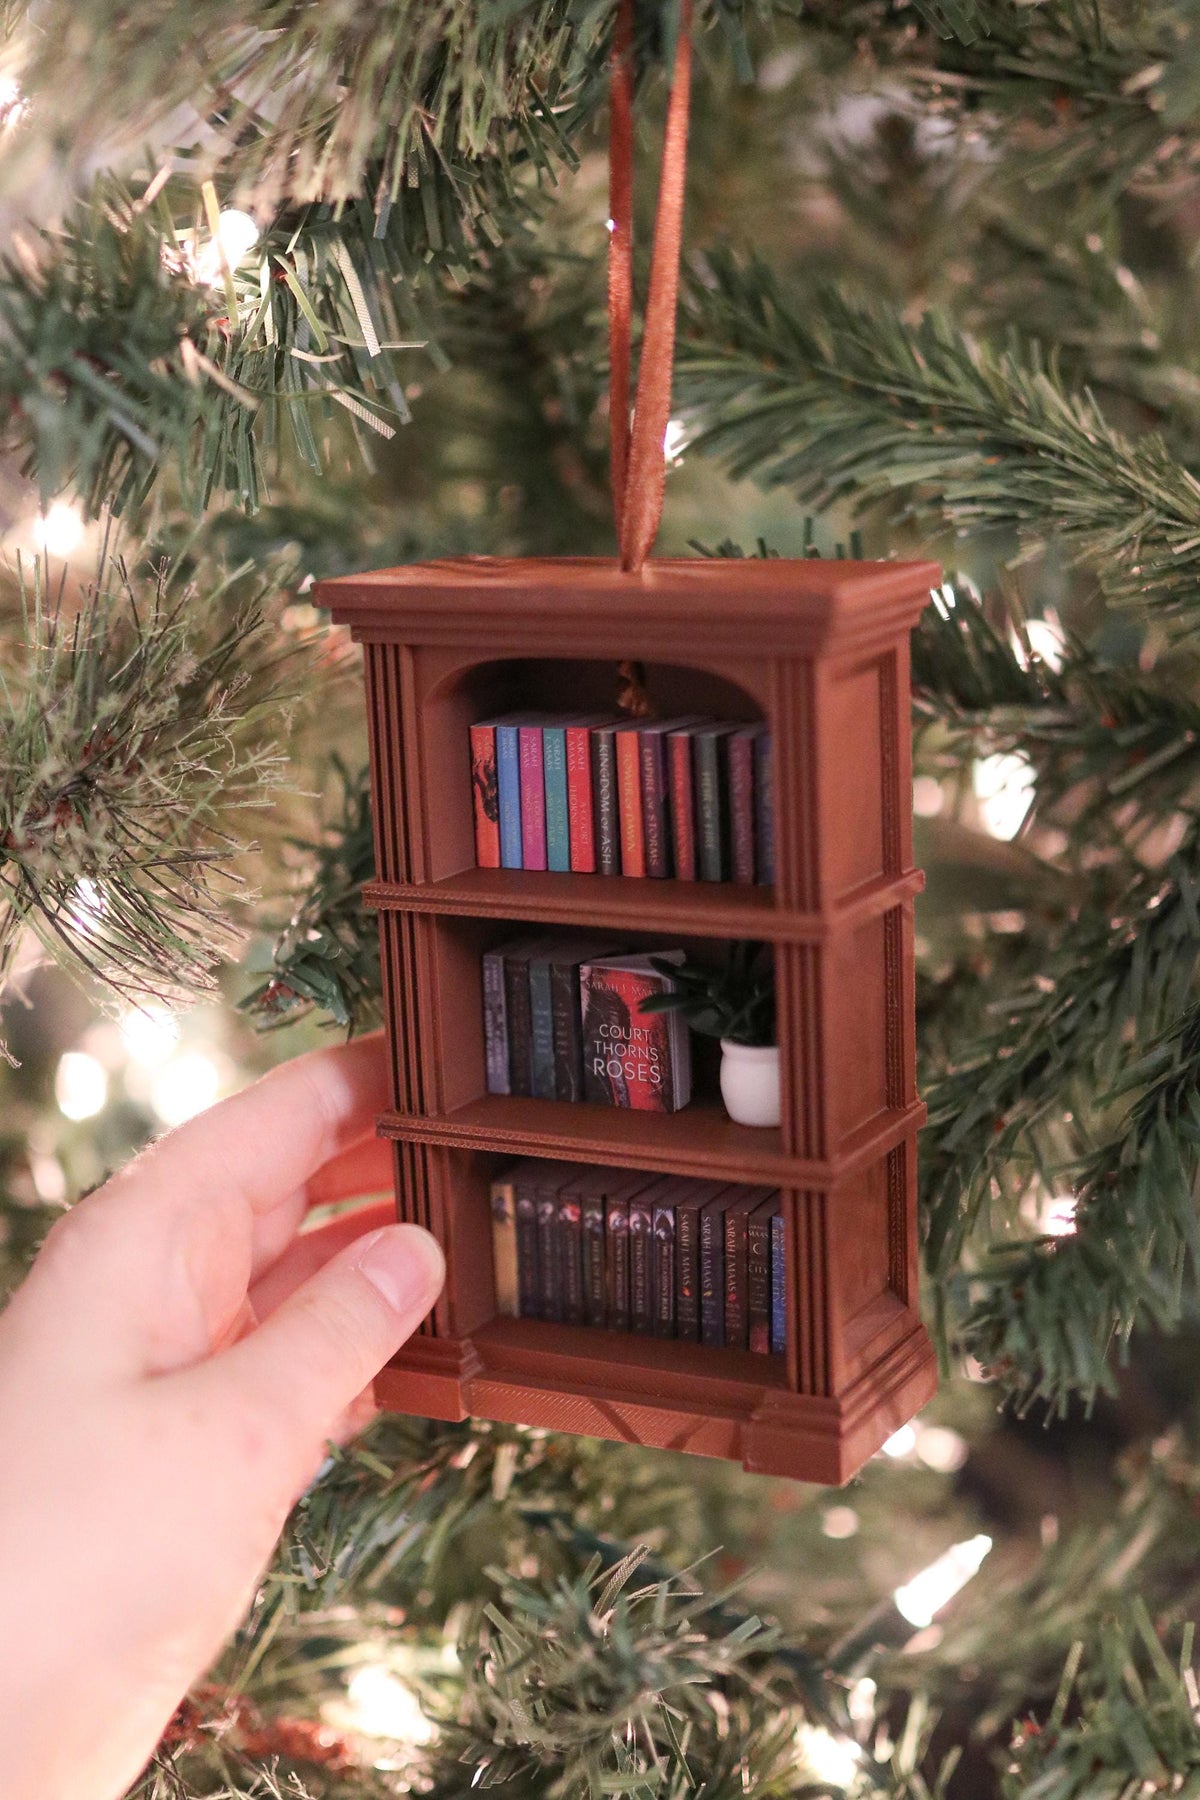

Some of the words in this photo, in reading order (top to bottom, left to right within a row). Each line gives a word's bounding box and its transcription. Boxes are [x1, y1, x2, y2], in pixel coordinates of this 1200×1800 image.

[569, 742, 577, 772] MAAS
[577, 733, 585, 770] SARAH
[600, 744, 610, 812] KINGDOM
[643, 748, 655, 793] EMPIRE
[602, 836, 611, 864] ASH
[648, 814, 658, 866] STORMS
[586, 980, 619, 993] SARAH
[599, 1024, 651, 1042] COURT
[594, 1040, 659, 1062] THORNS
[594, 1058, 661, 1084] ROSES
[681, 1214, 690, 1246] SARAH
[703, 1216, 711, 1249] SARAH
[727, 1220, 736, 1252] SARAH
[682, 1256, 691, 1285] MAAS
[704, 1258, 712, 1289] MAAS
[728, 1262, 736, 1292] MAAS
